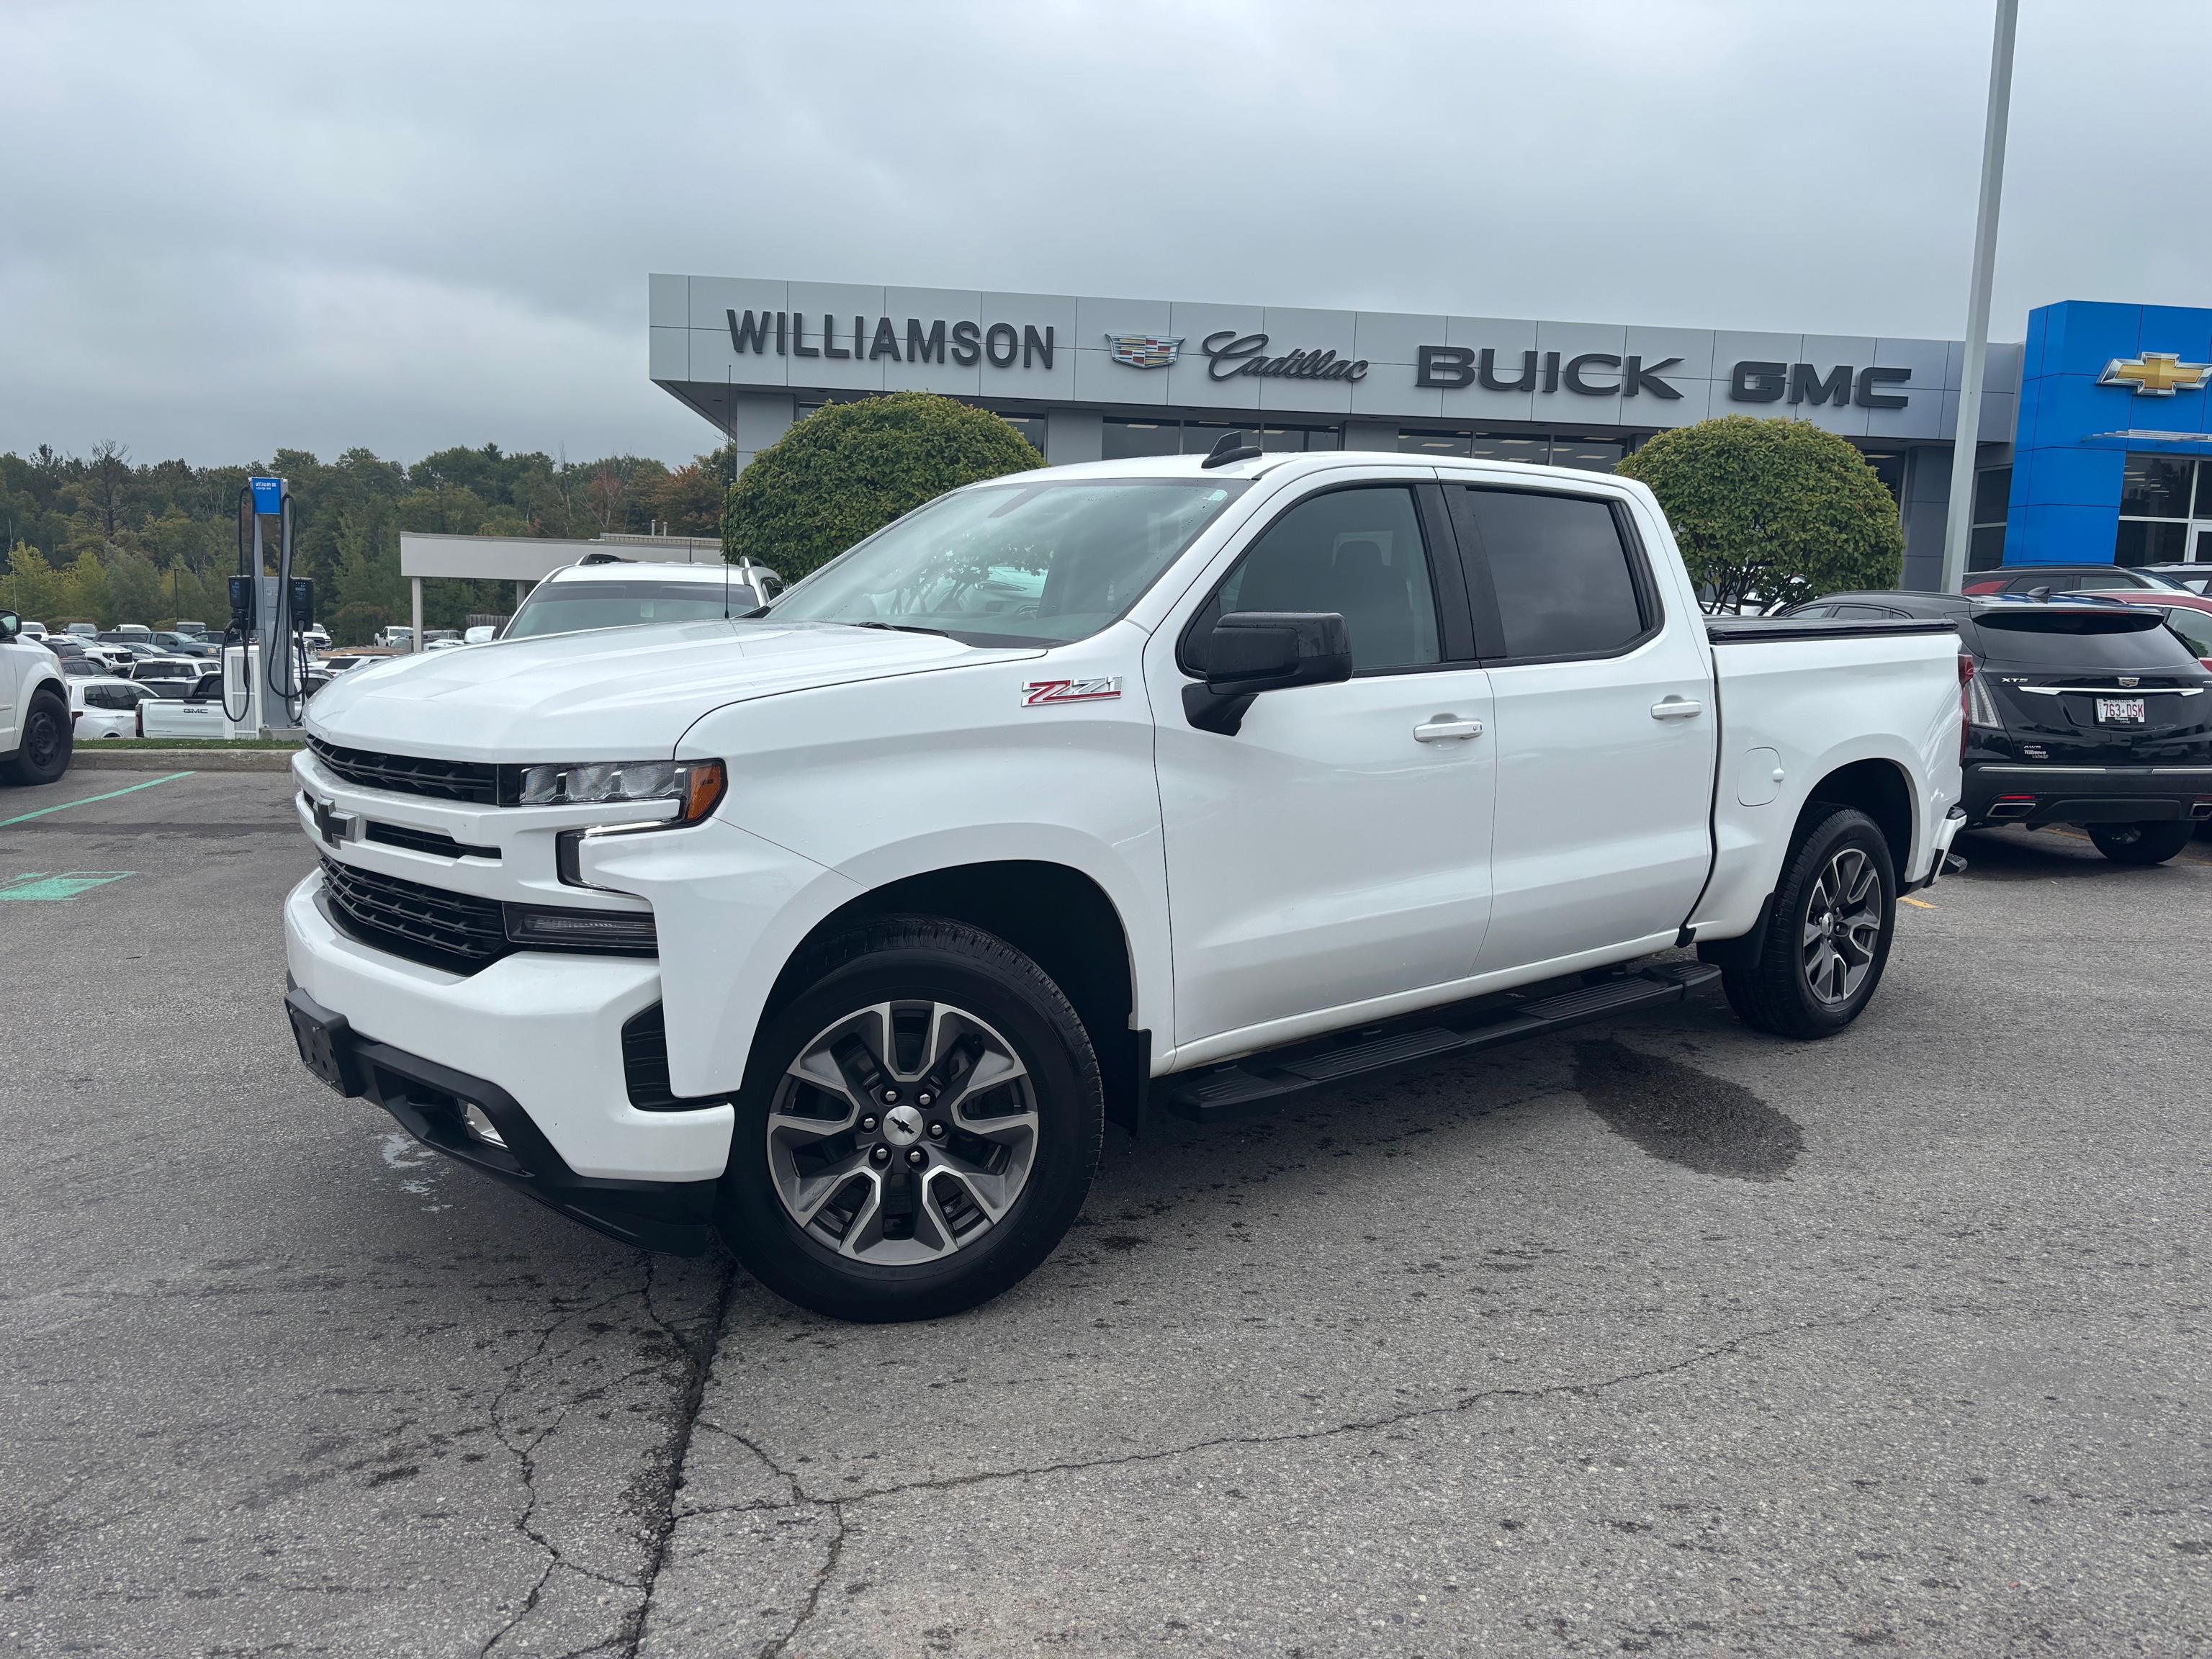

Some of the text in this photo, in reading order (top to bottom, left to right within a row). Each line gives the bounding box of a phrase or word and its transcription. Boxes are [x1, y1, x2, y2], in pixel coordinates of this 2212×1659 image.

[726, 308, 1054, 369] WILLIAMSON
[1202, 331, 1369, 382] Cadillac
[1415, 345, 1686, 399] BUICK
[1729, 361, 1912, 409] GMC
[2103, 703, 2144, 718] 763 DSK
